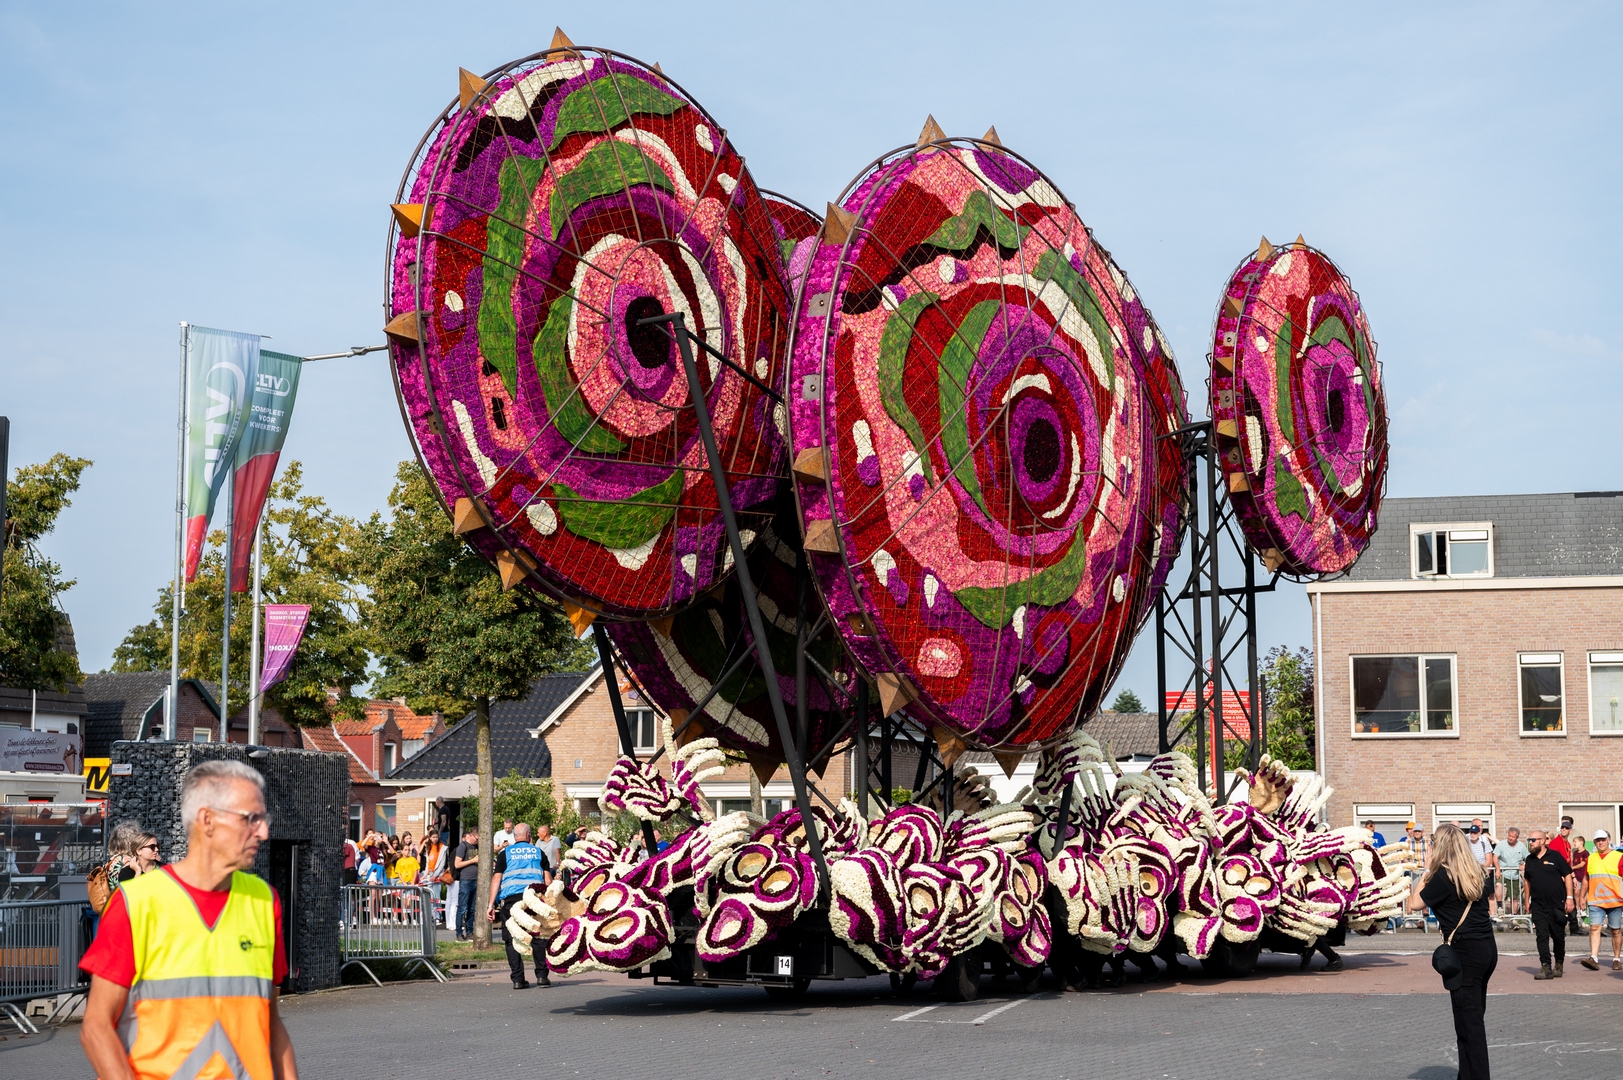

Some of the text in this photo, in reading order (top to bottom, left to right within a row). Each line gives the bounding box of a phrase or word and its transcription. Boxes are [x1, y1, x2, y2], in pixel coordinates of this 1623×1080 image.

[256, 373, 284, 390] LTV
[251, 404, 285, 417] COMPLEET
[259, 414, 276, 423] VOOR
[780, 958, 790, 969] 14
